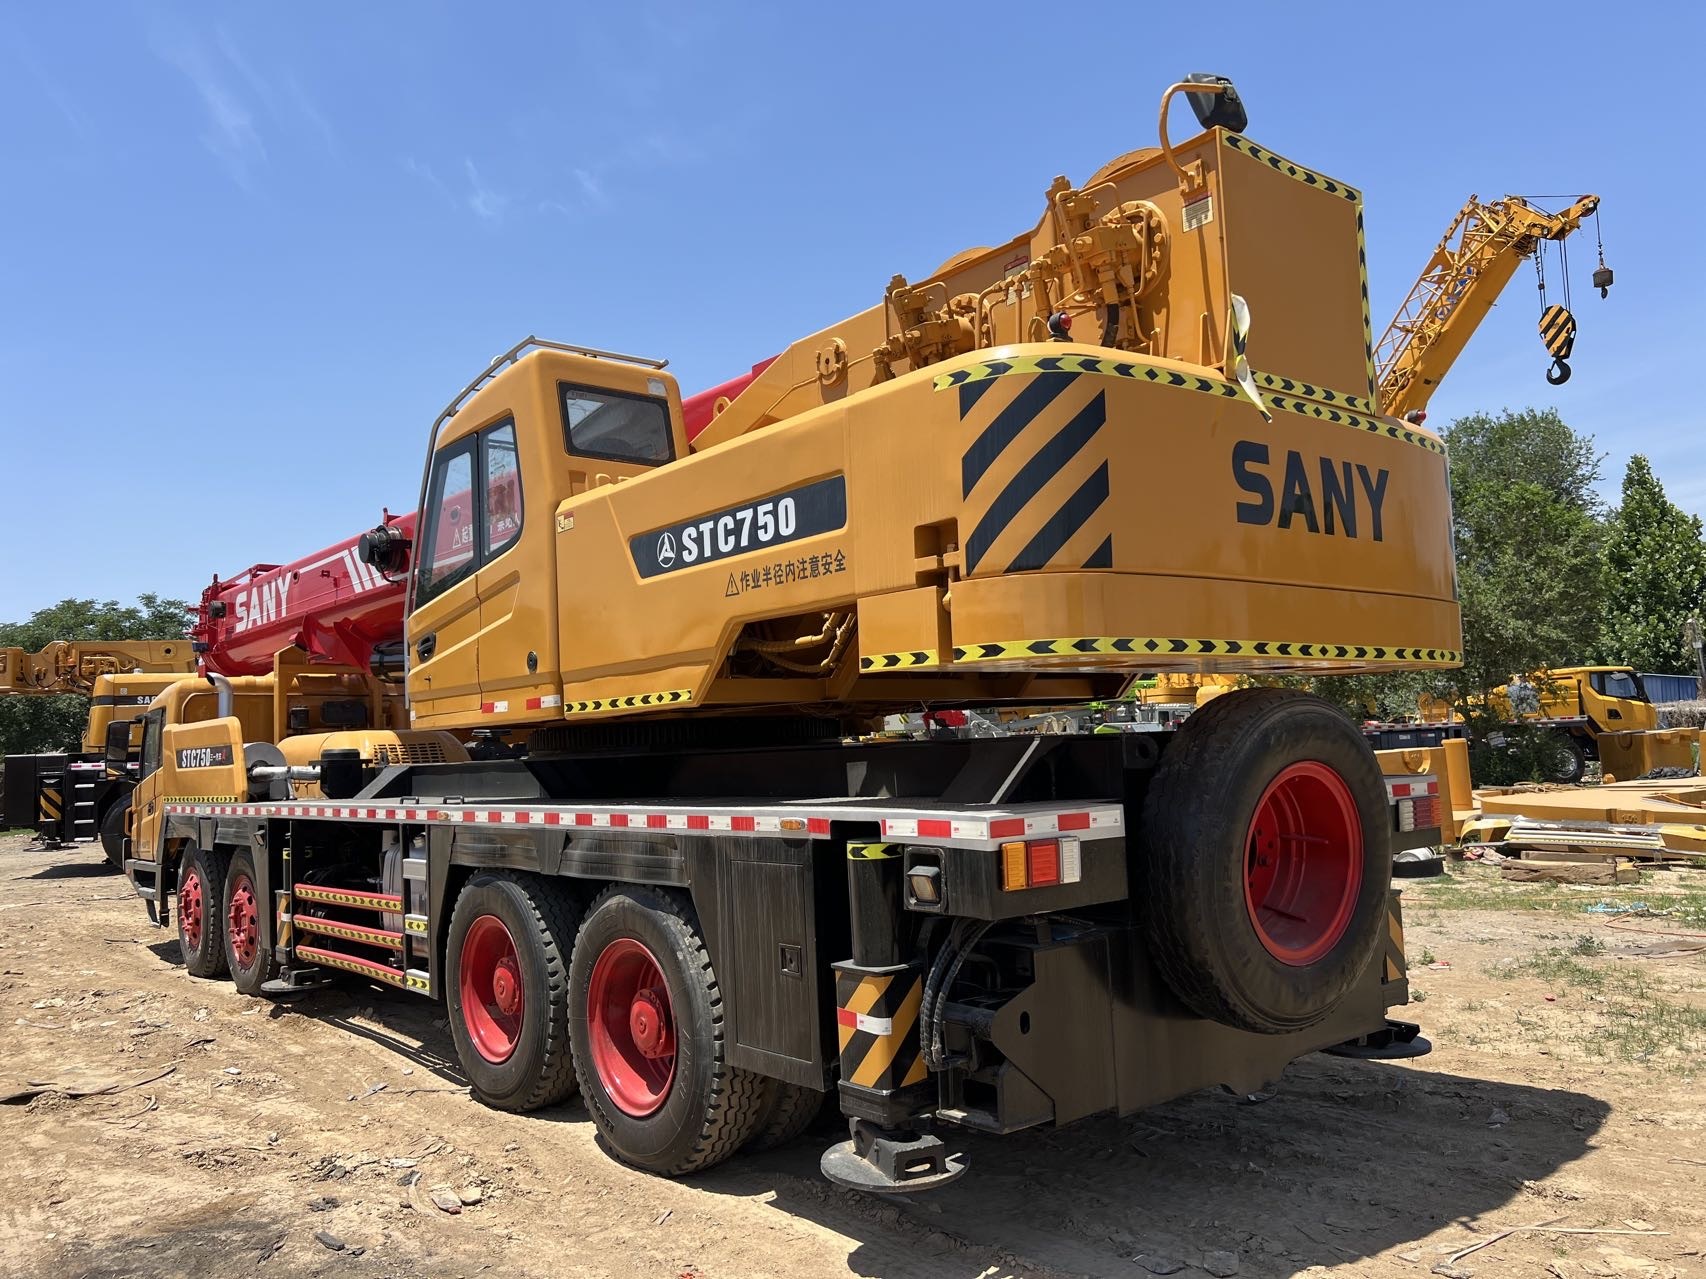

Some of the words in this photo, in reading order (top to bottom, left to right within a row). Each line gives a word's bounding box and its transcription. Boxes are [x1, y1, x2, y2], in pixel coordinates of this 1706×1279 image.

[1232, 440, 1389, 542] SANY
[681, 497, 796, 563] STC750
[740, 549, 846, 592] 作业半径内注意安全
[235, 572, 292, 632] SANY
[181, 748, 211, 768] STC750
